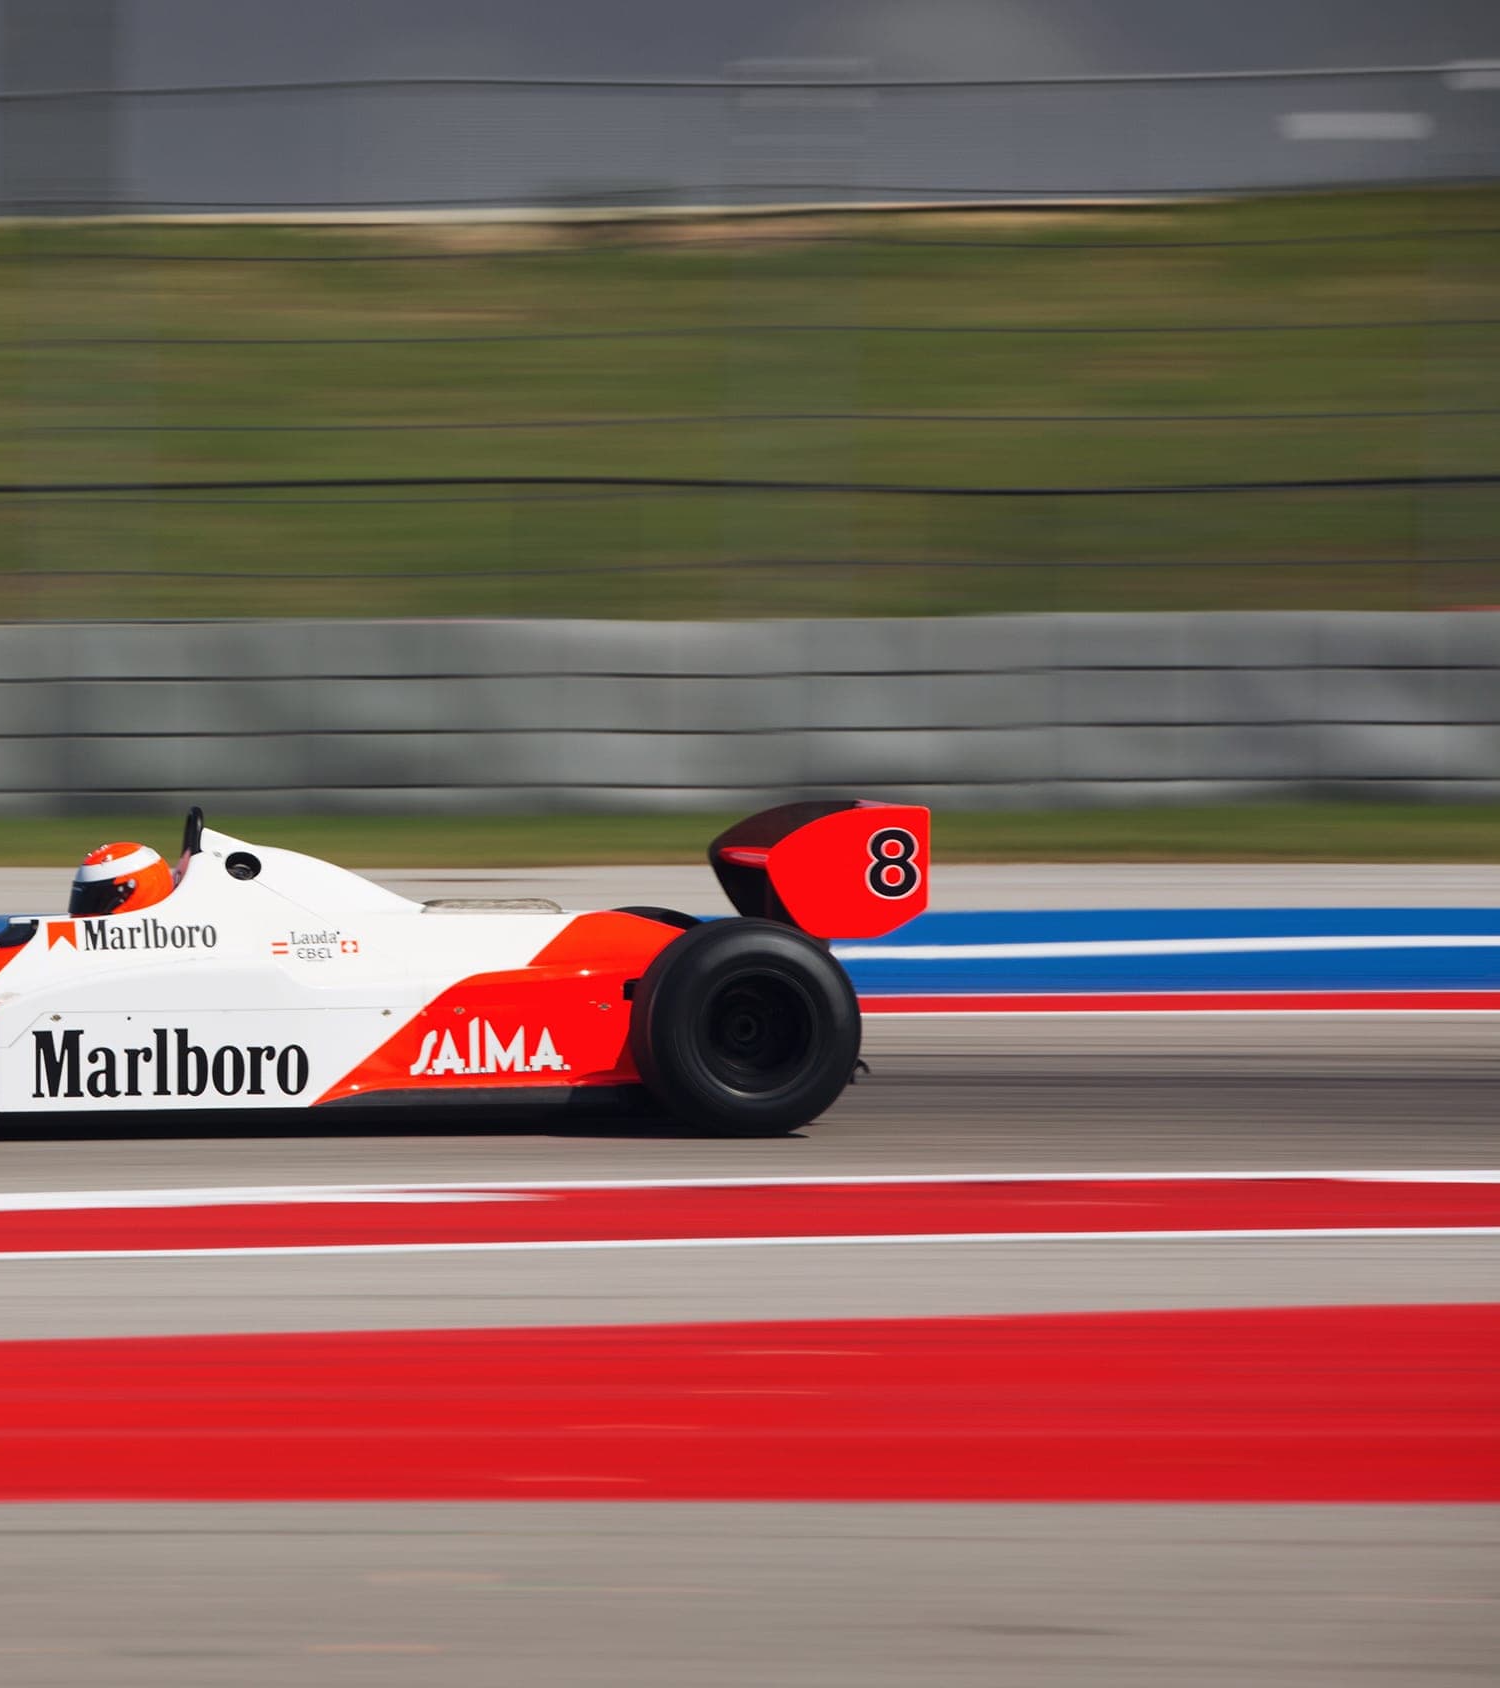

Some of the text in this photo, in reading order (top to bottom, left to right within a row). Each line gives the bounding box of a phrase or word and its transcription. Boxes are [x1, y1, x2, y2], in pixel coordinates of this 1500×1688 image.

[865, 827, 922, 900] 8
[83, 918, 217, 951] Marlboro
[290, 930, 338, 945] Lauda
[32, 1028, 309, 1098] Marlboro
